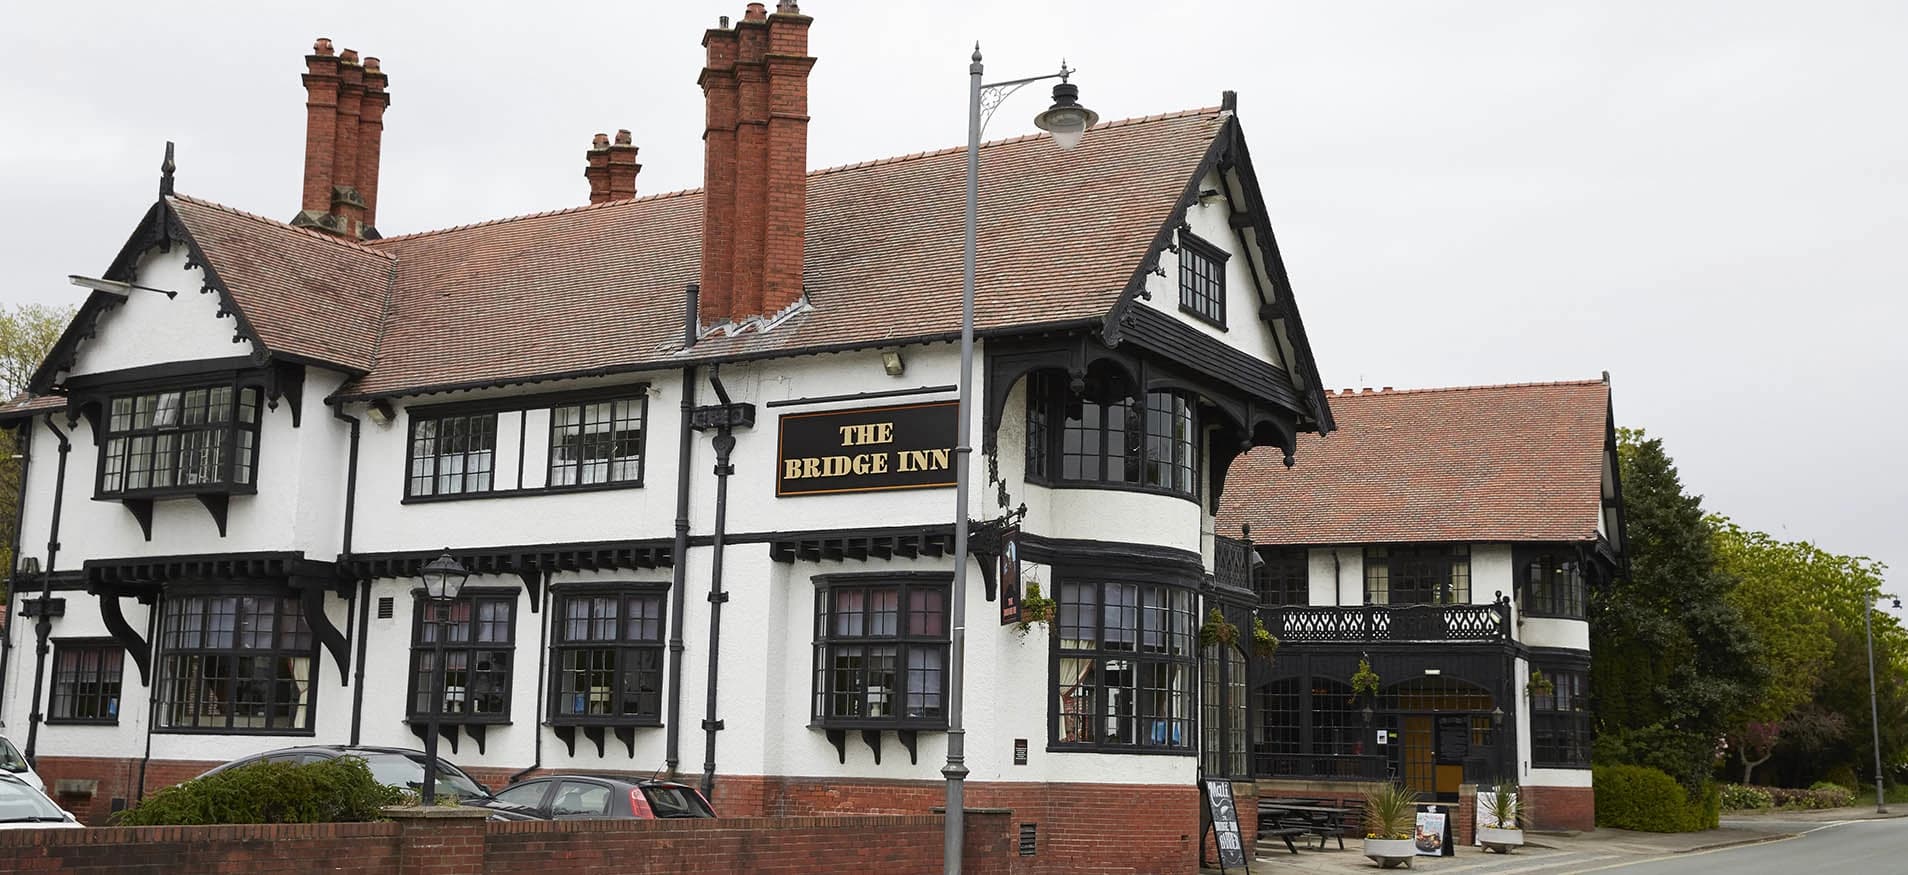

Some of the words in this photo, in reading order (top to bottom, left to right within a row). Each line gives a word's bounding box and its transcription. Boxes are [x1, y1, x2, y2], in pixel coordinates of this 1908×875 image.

[839, 422, 893, 446] THE
[784, 453, 888, 480] BRIDGE
[896, 449, 951, 473] INN
